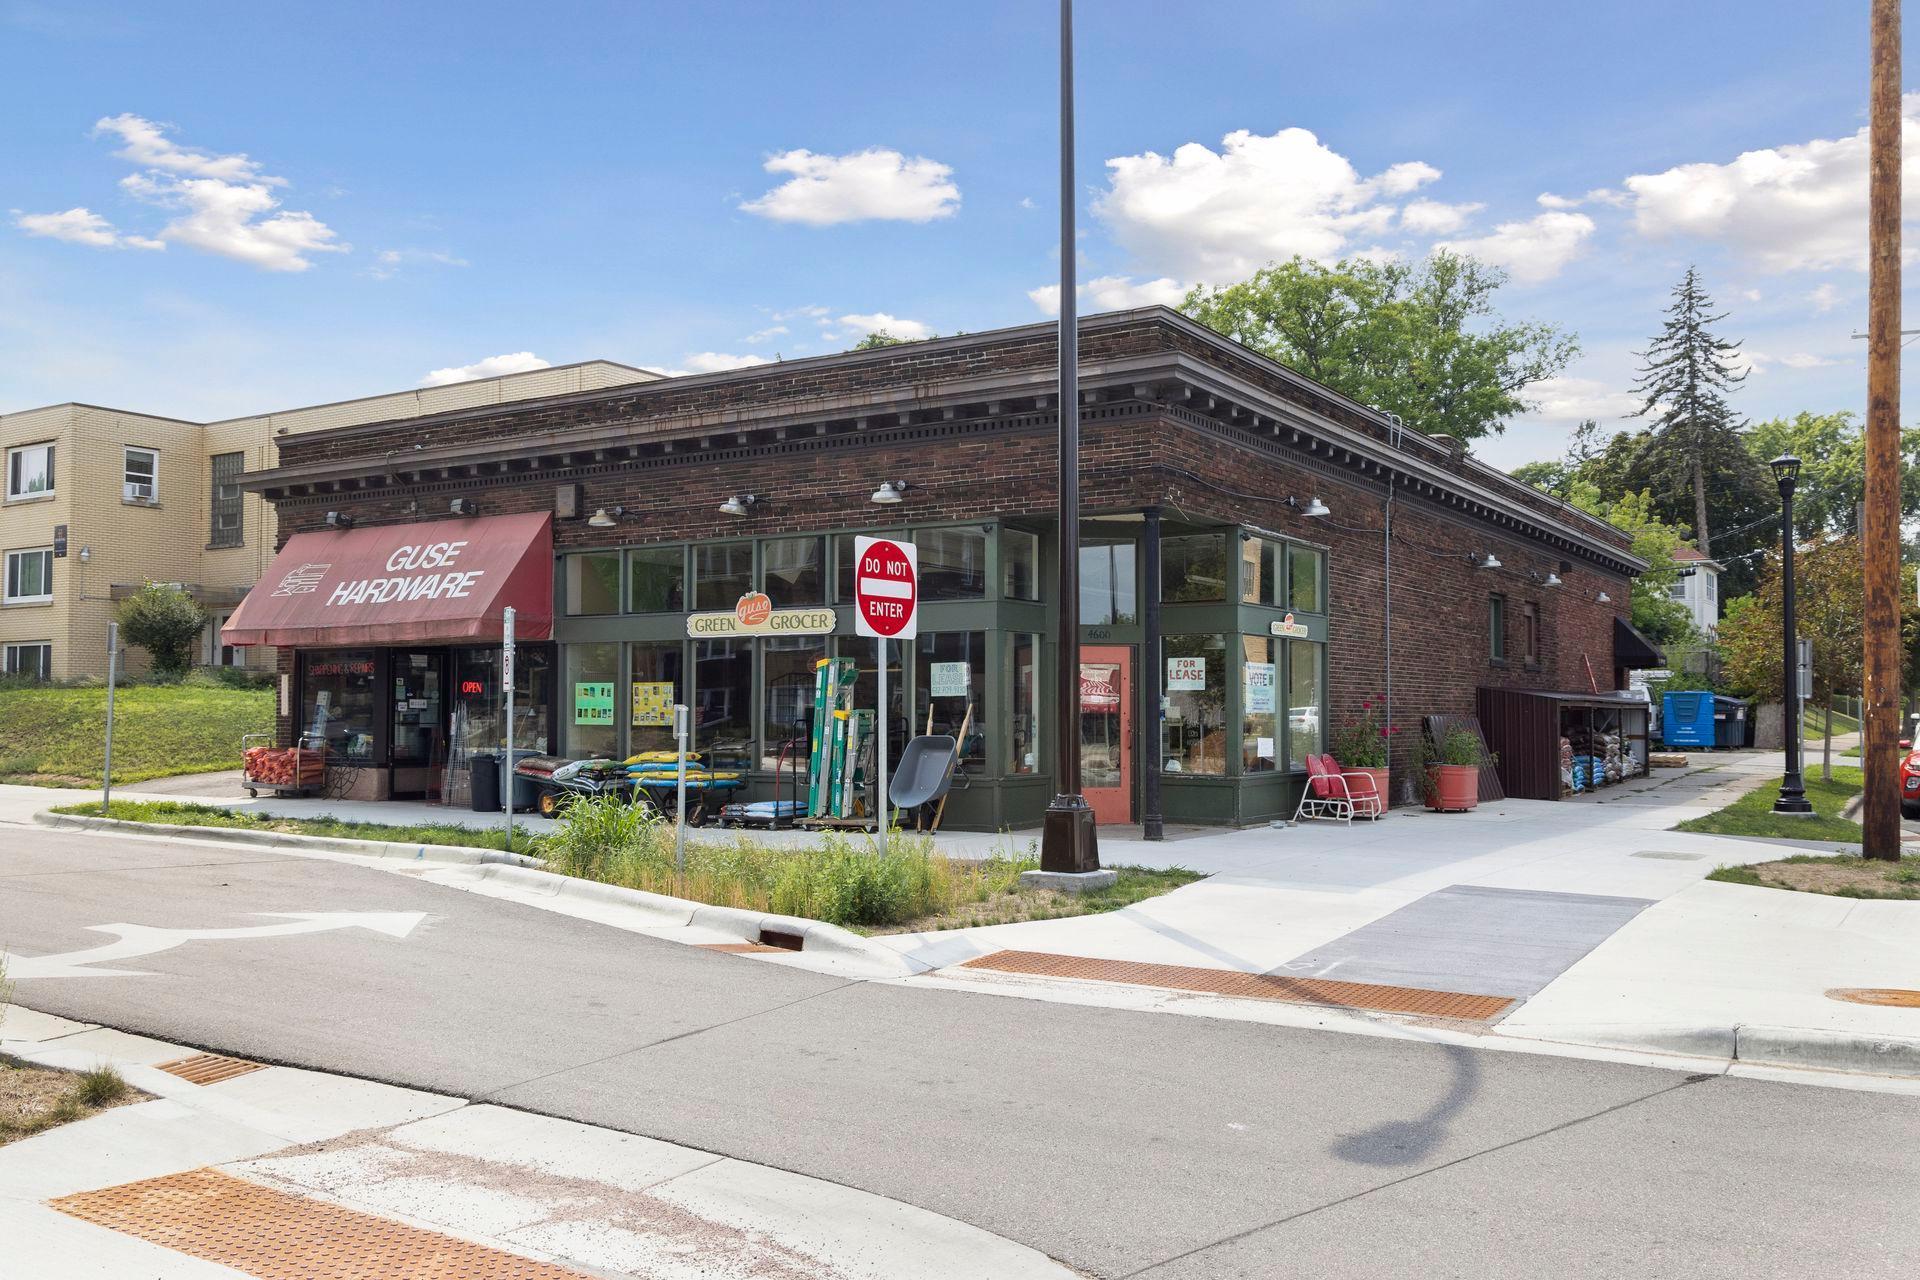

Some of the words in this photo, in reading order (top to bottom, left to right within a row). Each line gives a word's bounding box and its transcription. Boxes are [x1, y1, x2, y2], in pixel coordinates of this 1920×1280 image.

[386, 541, 468, 572] GUSE
[865, 558, 881, 574] DO
[886, 560, 908, 576] NOT
[326, 571, 485, 606] HARDWARE
[869, 601, 903, 618] ENTER
[695, 617, 736, 632] GREEN
[770, 614, 828, 630] GROCER
[1087, 629, 1111, 640] 4600
[940, 663, 960, 673] FOR
[1177, 660, 1196, 668] FOR
[1169, 669, 1204, 681] LEASE
[1249, 672, 1268, 687] VOTE
[462, 681, 483, 693] OPEN
